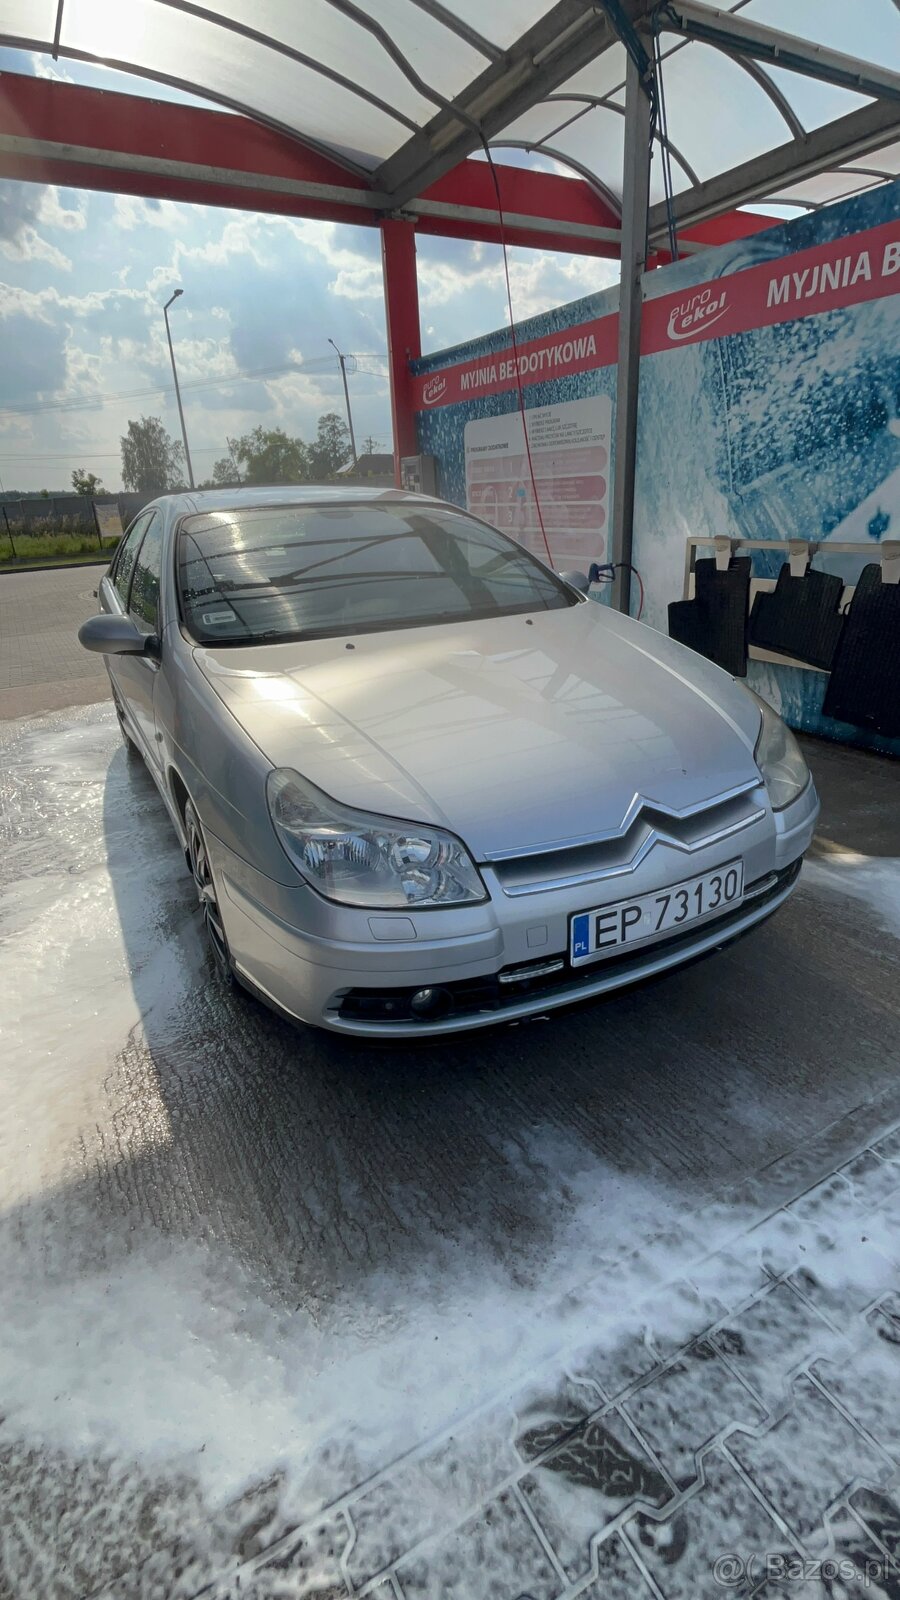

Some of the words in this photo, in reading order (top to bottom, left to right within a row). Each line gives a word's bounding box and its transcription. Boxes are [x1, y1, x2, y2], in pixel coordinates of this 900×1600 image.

[766, 251, 872, 308] MYJNIA
[670, 289, 711, 318] euro
[682, 292, 726, 328] ekol
[460, 366, 497, 391] MYJNIA
[499, 335, 597, 379] BEZDOTYKOWA
[423, 375, 440, 390] euro
[429, 379, 446, 398] ekol
[508, 486, 513, 498] 2
[507, 511, 513, 522] 3
[595, 905, 642, 949] EP
[655, 869, 738, 931] 73130
[575, 942, 587, 952] PL
